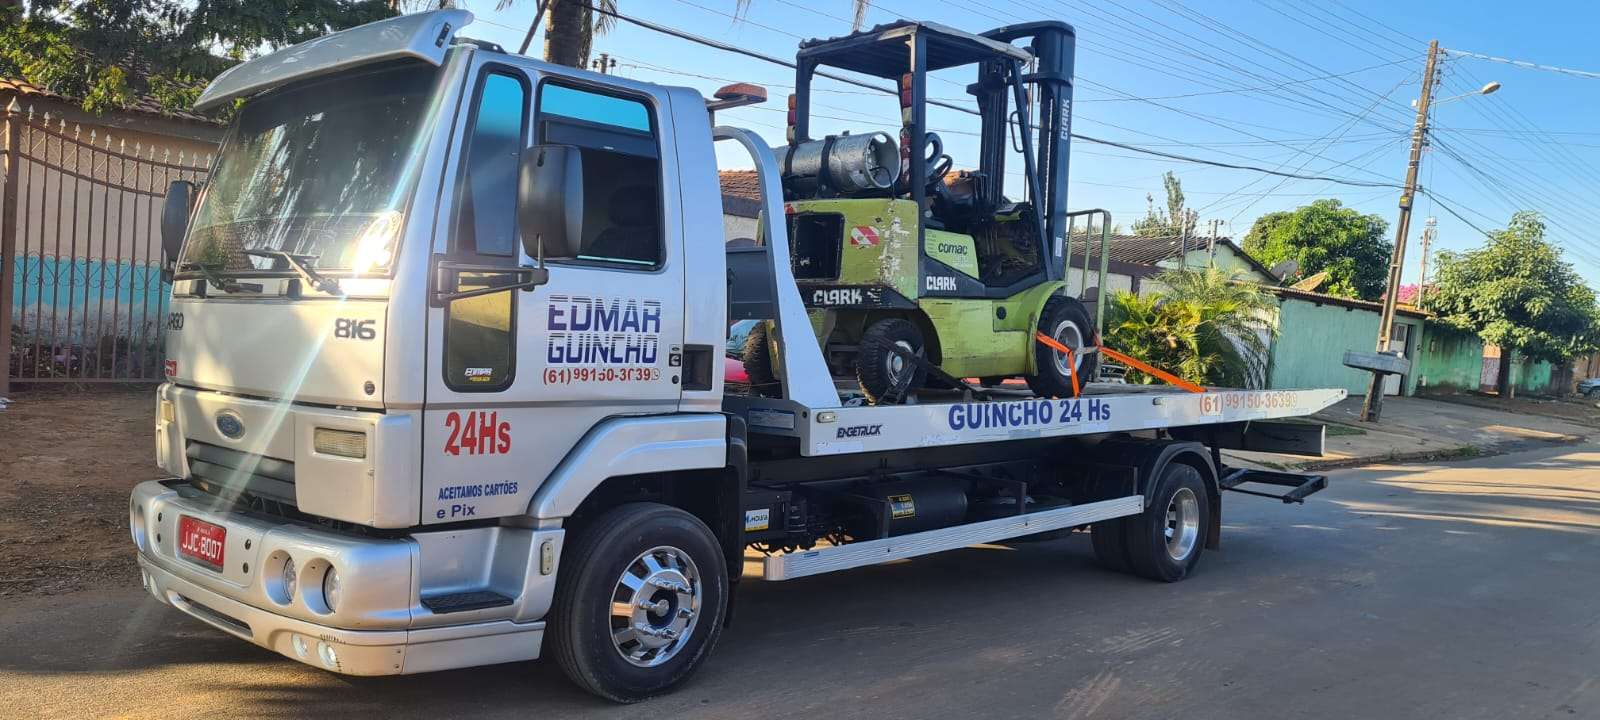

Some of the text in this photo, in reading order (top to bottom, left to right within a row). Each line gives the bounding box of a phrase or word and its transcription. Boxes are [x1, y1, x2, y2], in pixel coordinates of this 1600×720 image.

[1060, 98, 1070, 141] CLARK
[938, 242, 968, 255] comac
[926, 276, 957, 291] CLARK
[813, 288, 863, 305] CLARK
[167, 311, 185, 331] ARGO
[547, 294, 661, 333] EDMAR
[334, 318, 376, 339] 816
[547, 332, 658, 364] GUINCHO
[949, 398, 1111, 431] GUINCHO 24 Hs
[444, 411, 511, 456] 24Hs
[837, 424, 883, 438] ENGETRUCK
[438, 480, 518, 501] ACEITAMOS CARTÕES
[436, 504, 476, 519] e Pix
